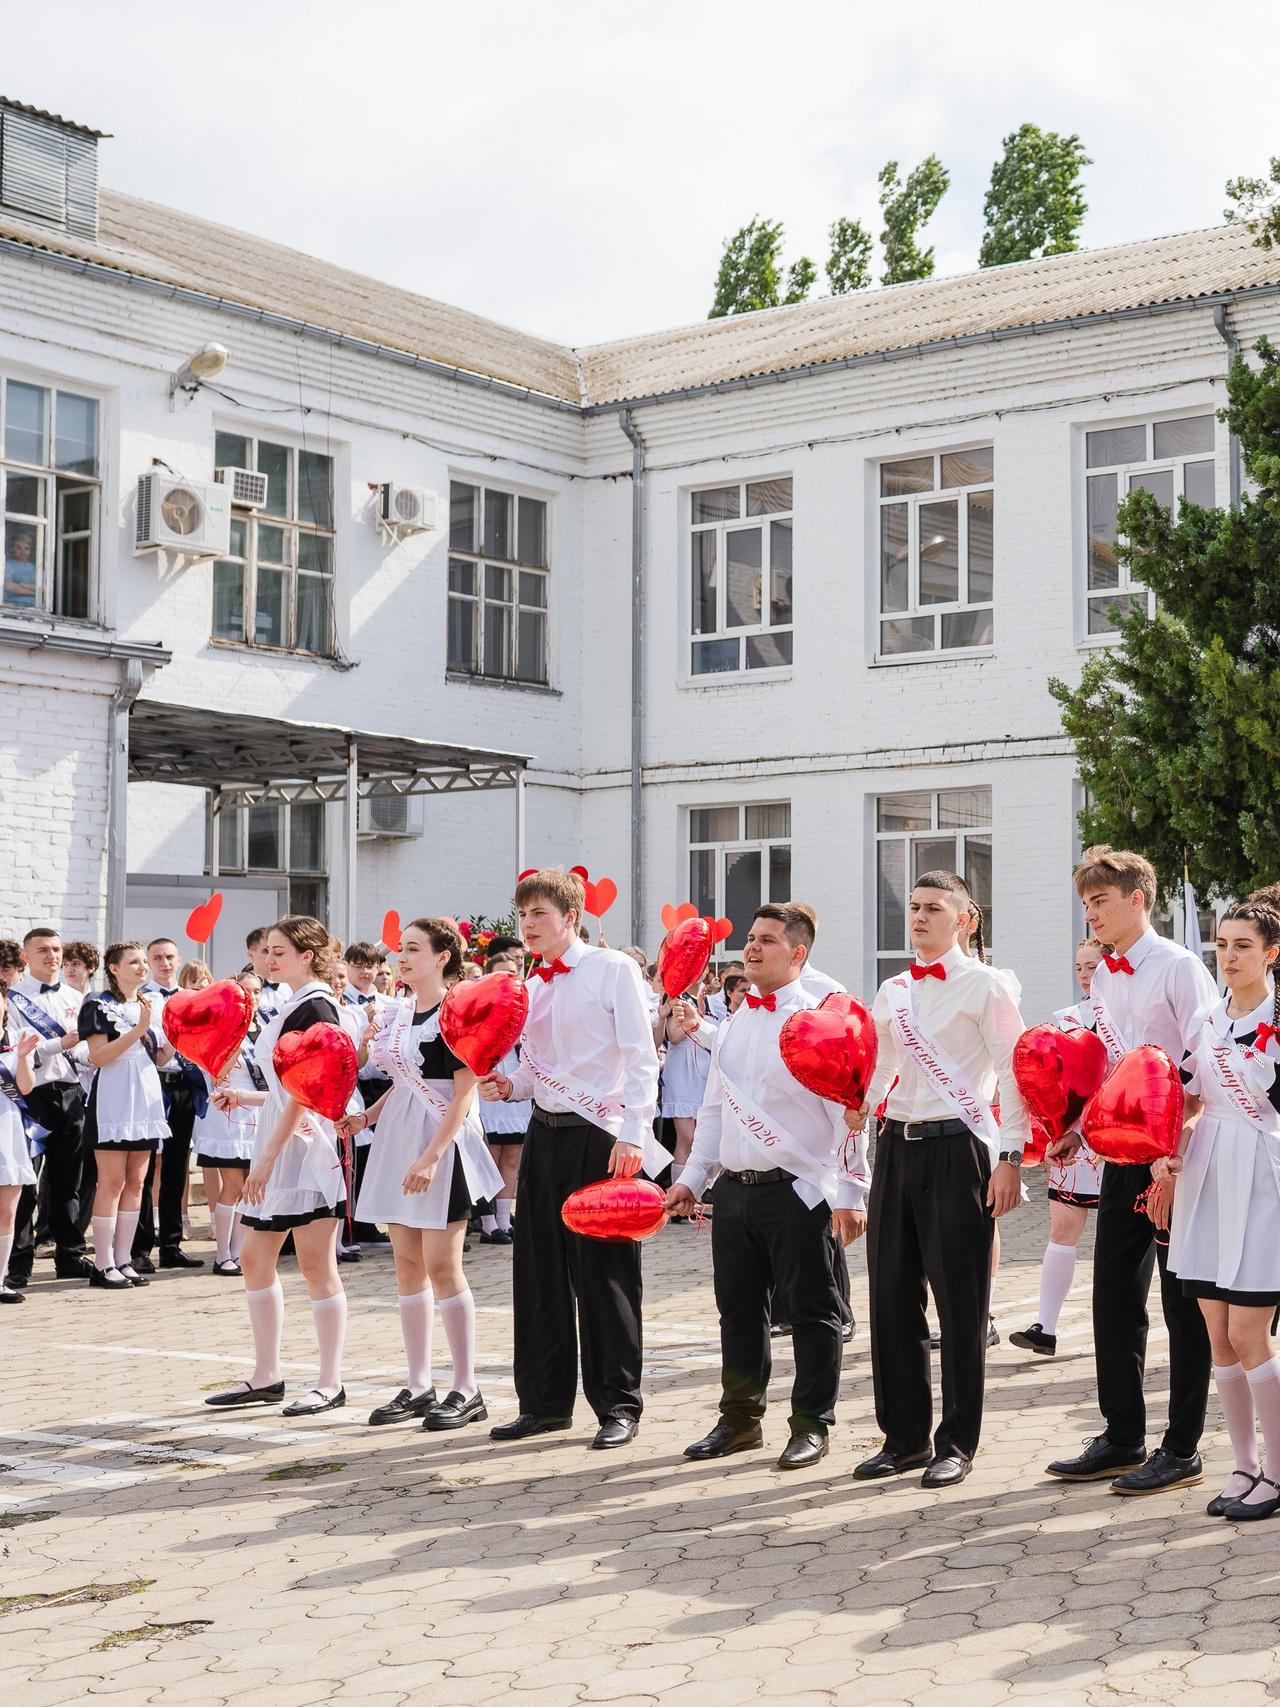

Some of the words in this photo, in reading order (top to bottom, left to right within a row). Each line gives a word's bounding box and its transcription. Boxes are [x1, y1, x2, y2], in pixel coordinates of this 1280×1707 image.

[895, 997, 954, 1085] Выпускник
[948, 1088, 985, 1123] 2026
[567, 1090, 611, 1117] 2026
[739, 1113, 781, 1146] 2026
